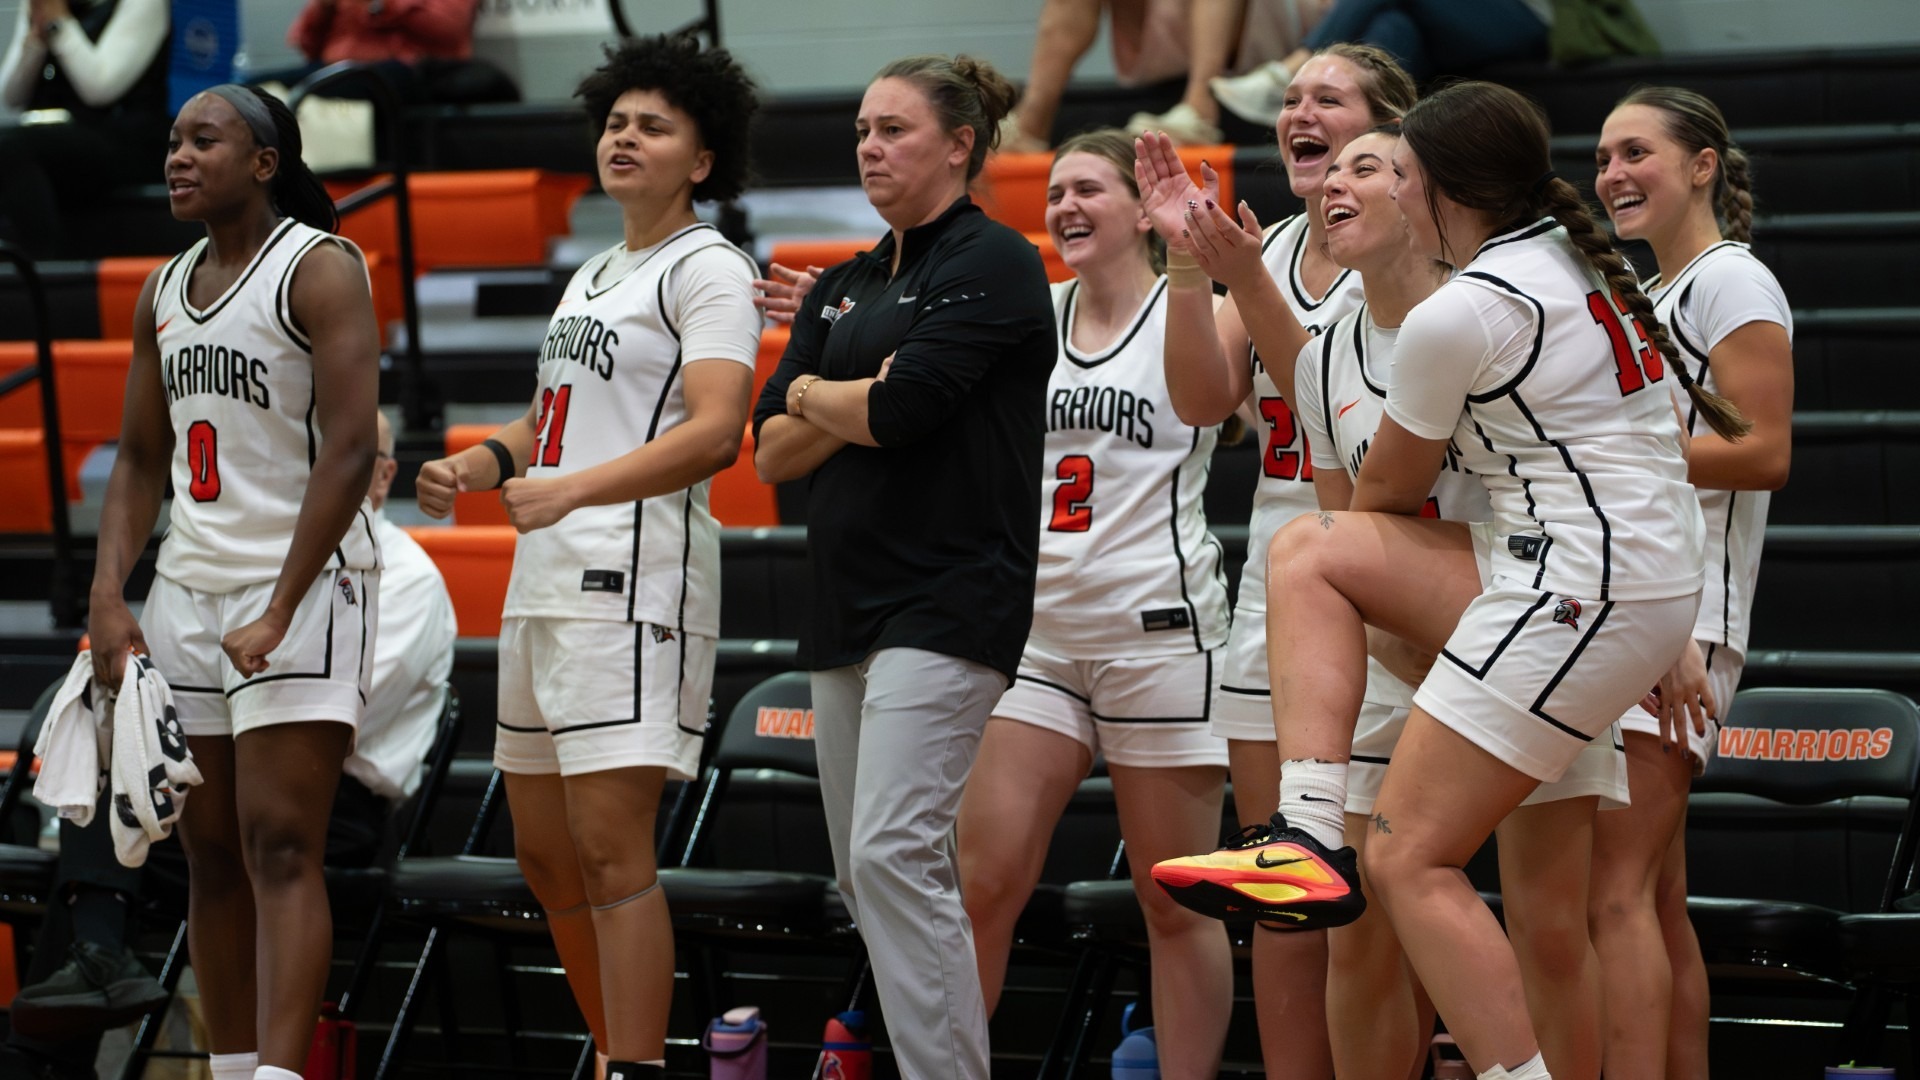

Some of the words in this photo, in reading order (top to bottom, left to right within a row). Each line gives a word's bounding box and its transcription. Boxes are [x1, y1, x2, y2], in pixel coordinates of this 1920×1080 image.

[538, 315, 619, 381] RRIORS
[1045, 386, 1155, 449] RRIORS
[187, 419, 221, 503] 0
[1048, 454, 1094, 532] 2
[1526, 543, 1535, 553] M
[1717, 726, 1893, 761] WARRIORS
